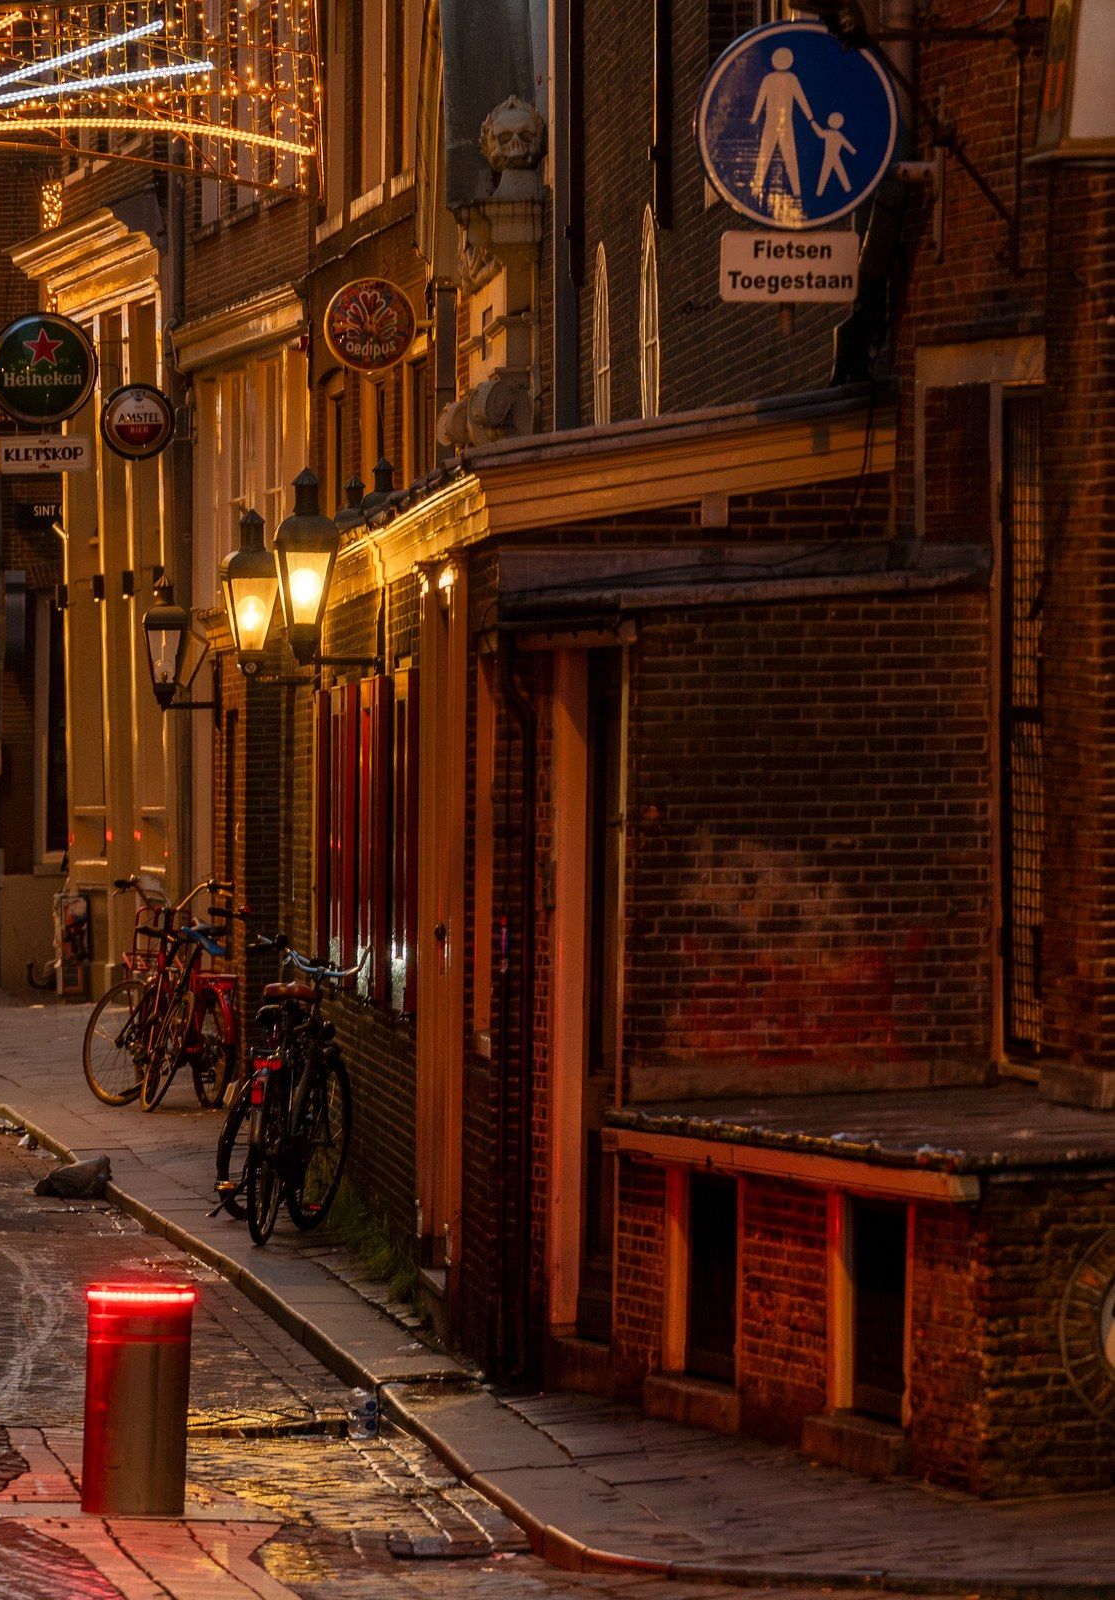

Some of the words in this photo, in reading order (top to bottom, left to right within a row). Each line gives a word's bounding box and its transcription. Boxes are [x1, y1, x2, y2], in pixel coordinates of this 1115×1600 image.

[753, 240, 832, 260] Fietsen
[727, 270, 854, 293] Toegestaan
[345, 337, 397, 360] oedipus
[3, 370, 82, 387] Heineken
[118, 412, 160, 423] AMSTEL
[130, 425, 149, 434] BIER
[3, 447, 84, 462] KLETSKOP
[33, 505, 56, 516] SINT
